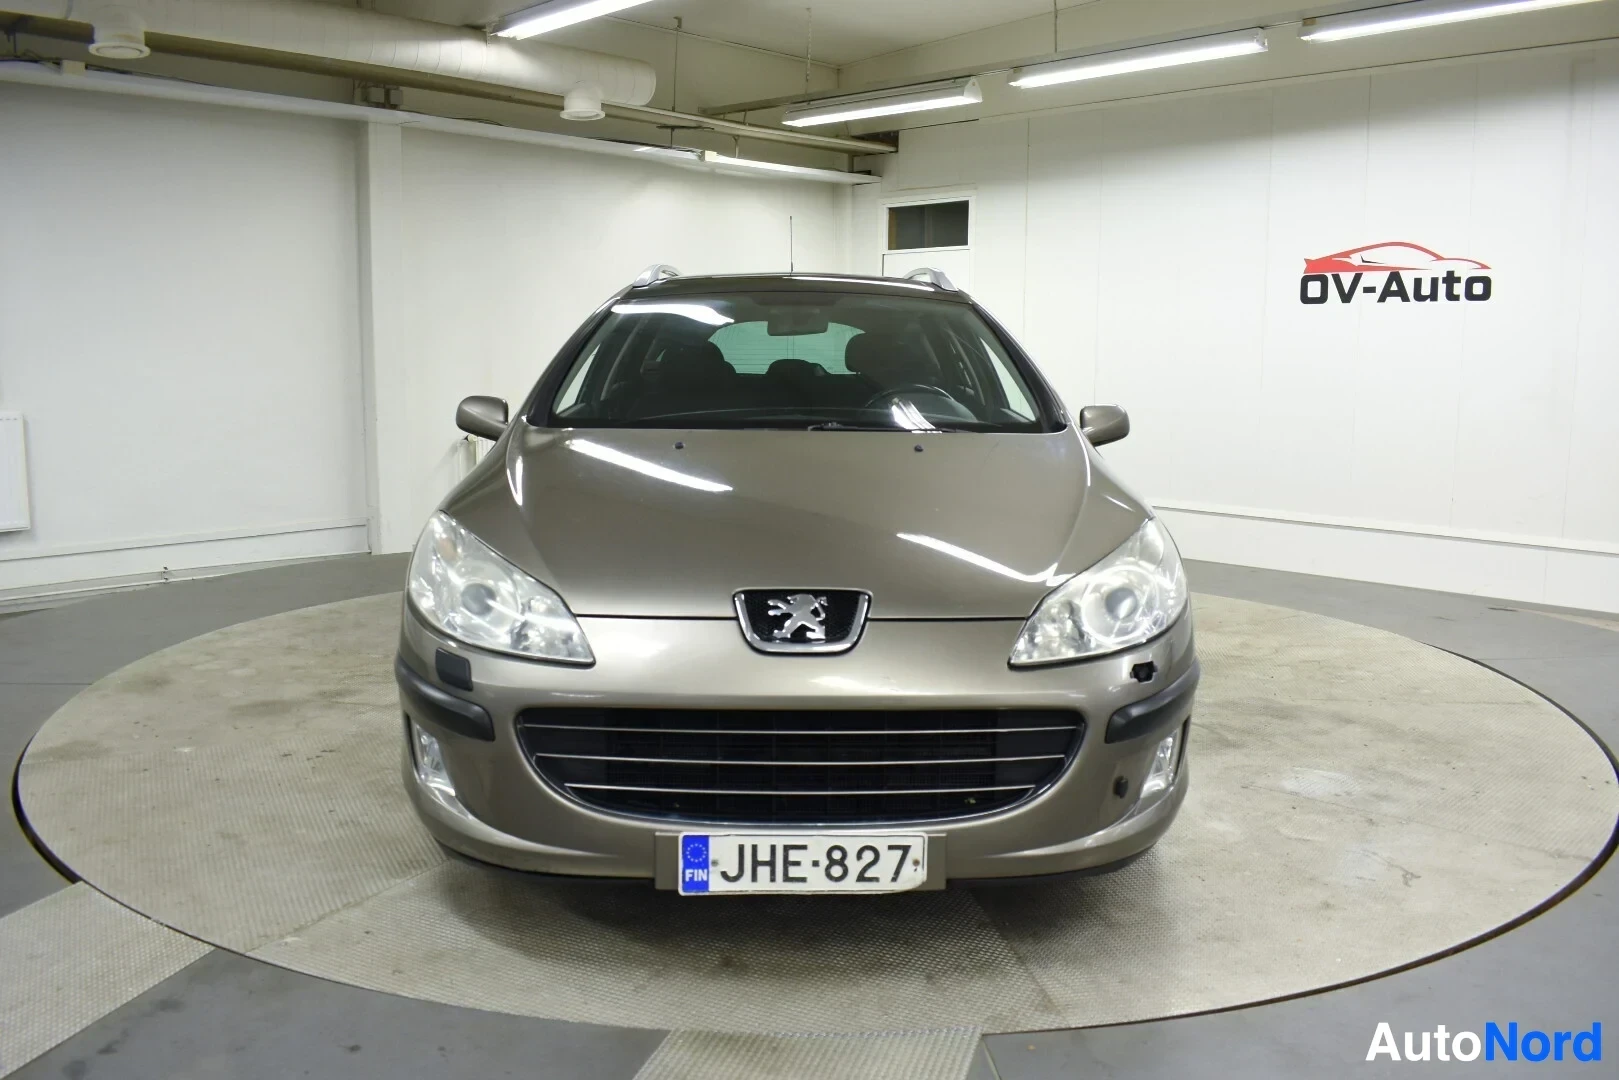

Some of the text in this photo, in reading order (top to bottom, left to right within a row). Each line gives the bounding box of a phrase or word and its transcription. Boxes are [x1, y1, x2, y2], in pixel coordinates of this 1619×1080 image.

[1300, 271, 1492, 305] OV-Auto
[685, 868, 708, 882] FIN
[720, 844, 912, 883] JHE-827
